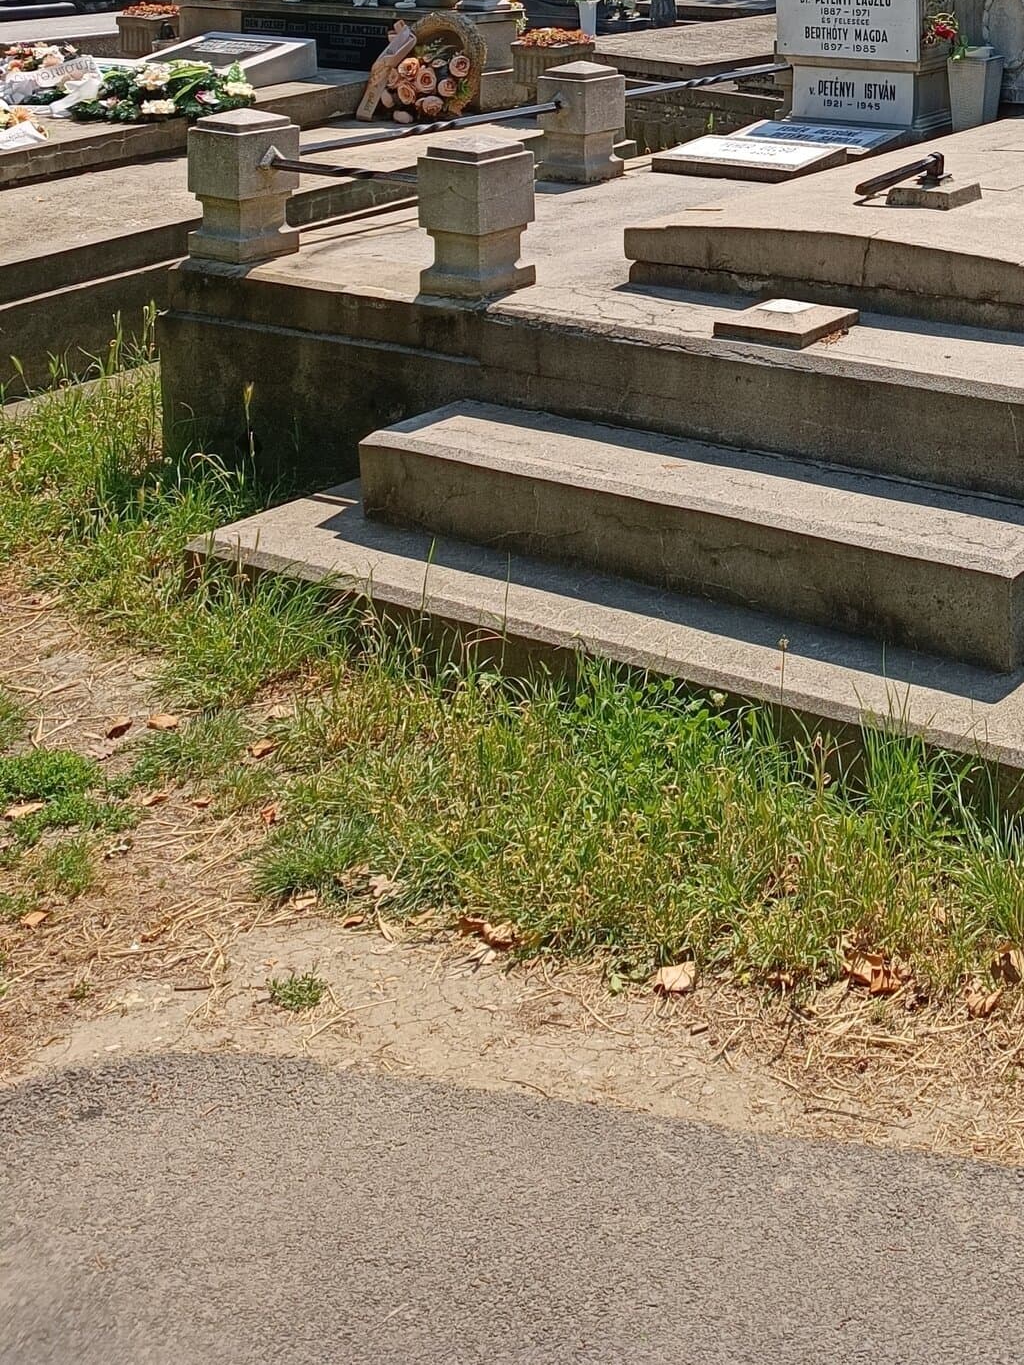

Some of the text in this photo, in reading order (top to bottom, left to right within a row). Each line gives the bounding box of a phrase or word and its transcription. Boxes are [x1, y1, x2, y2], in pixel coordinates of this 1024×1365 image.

[805, 25, 888, 43] BERTHÓTY MAGDA
[818, 76, 855, 98] PETÉNYI
[864, 80, 896, 101] ISTVÁN
